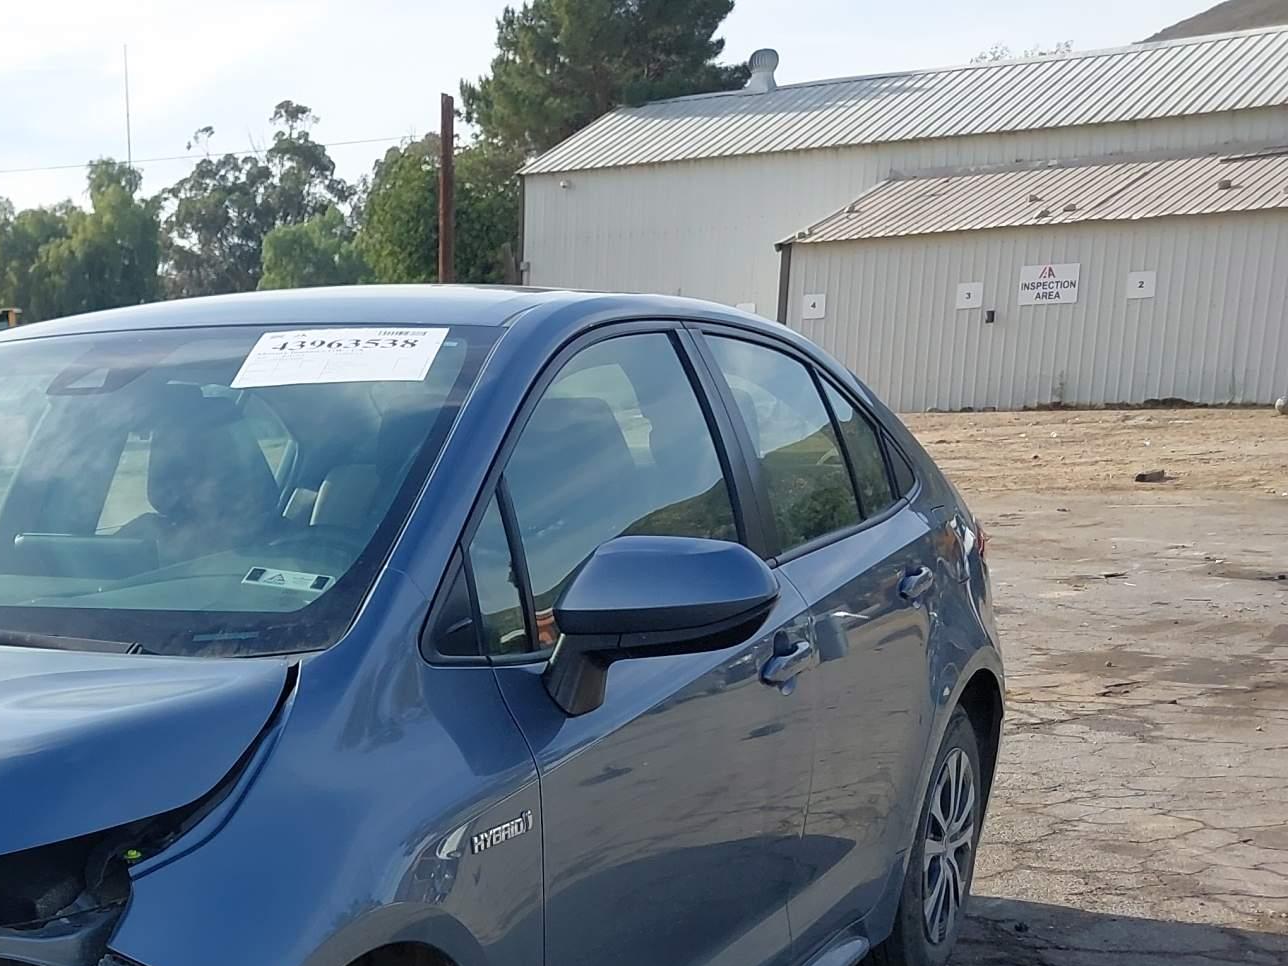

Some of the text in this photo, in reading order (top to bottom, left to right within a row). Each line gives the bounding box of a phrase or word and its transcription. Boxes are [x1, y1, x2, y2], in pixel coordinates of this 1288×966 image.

[1021, 280, 1076, 291] INSPECTION
[1137, 280, 1145, 289] 2
[965, 292, 971, 300] 3
[1035, 291, 1060, 300] AREA
[811, 301, 817, 309] 4
[272, 338, 419, 352] 43963538
[472, 816, 525, 854] HYBRID
